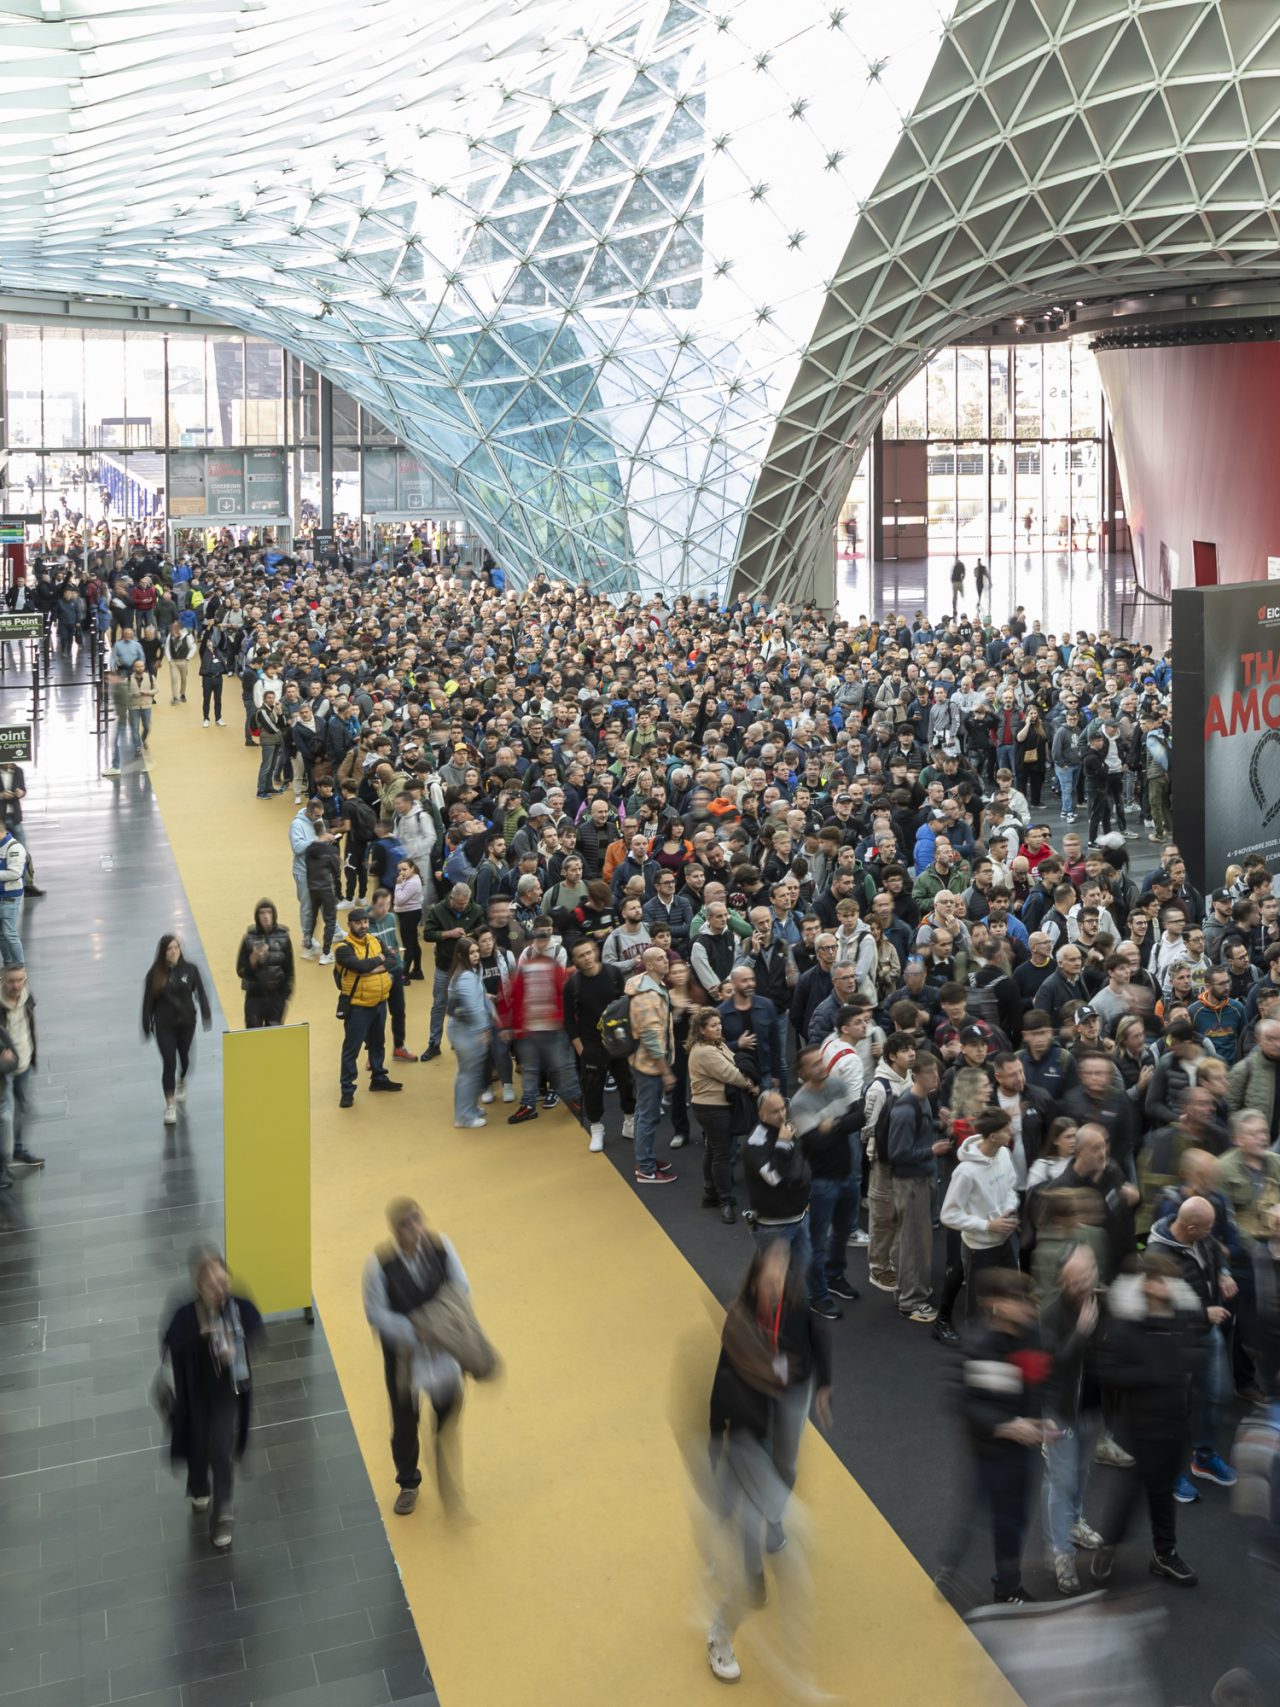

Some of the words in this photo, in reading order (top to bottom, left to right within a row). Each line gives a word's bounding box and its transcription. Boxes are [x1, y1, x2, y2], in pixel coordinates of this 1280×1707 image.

[14, 617, 38, 625] Point
[0, 730, 26, 741] oint
[1238, 842, 1265, 854] NOVEMBRE
